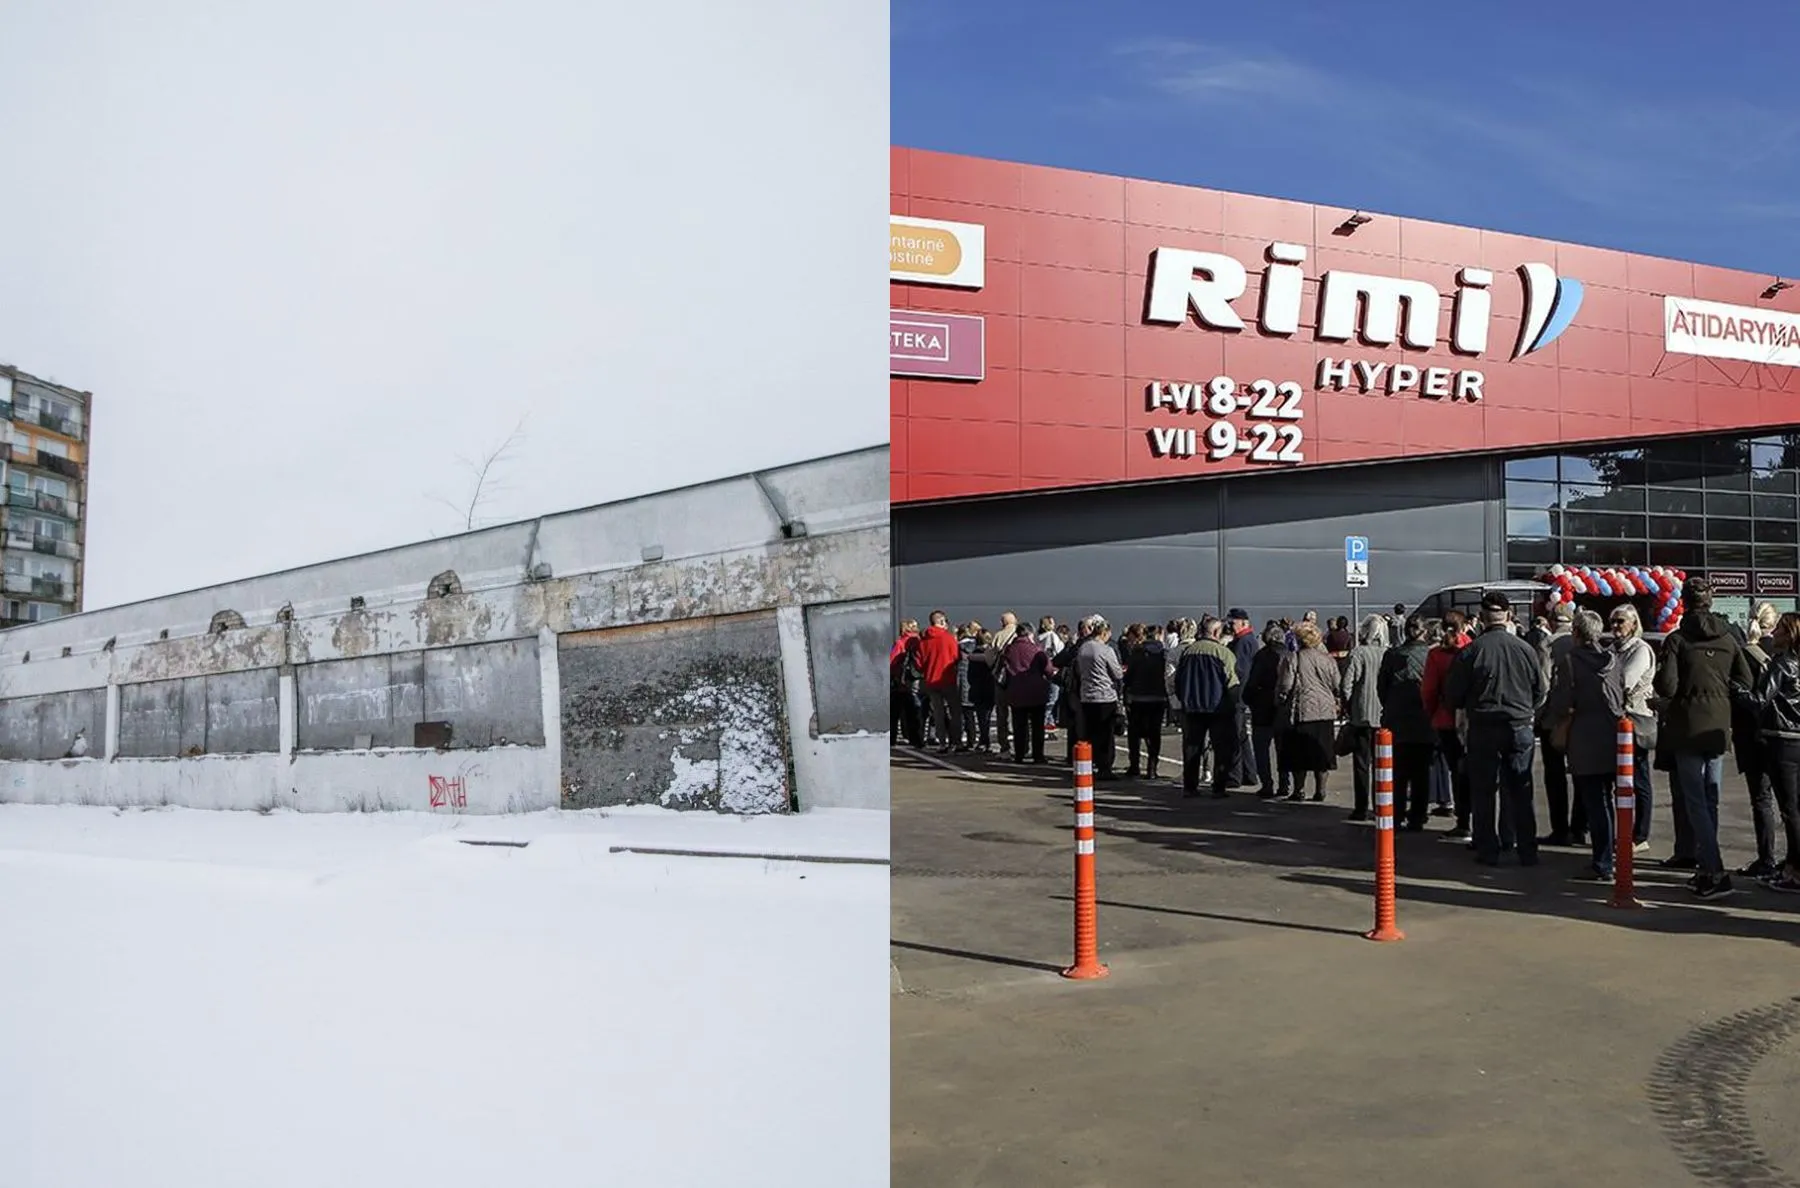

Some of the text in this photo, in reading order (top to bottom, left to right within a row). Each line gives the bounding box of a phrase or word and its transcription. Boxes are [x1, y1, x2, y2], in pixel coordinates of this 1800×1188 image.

[1143, 241, 1494, 356] Rimi
[890, 332, 942, 350] TEKA
[1206, 375, 1304, 421] 8-22
[1316, 357, 1485, 401] HYPER
[1148, 420, 1304, 463] VII 9-22
[1352, 540, 1364, 559] P
